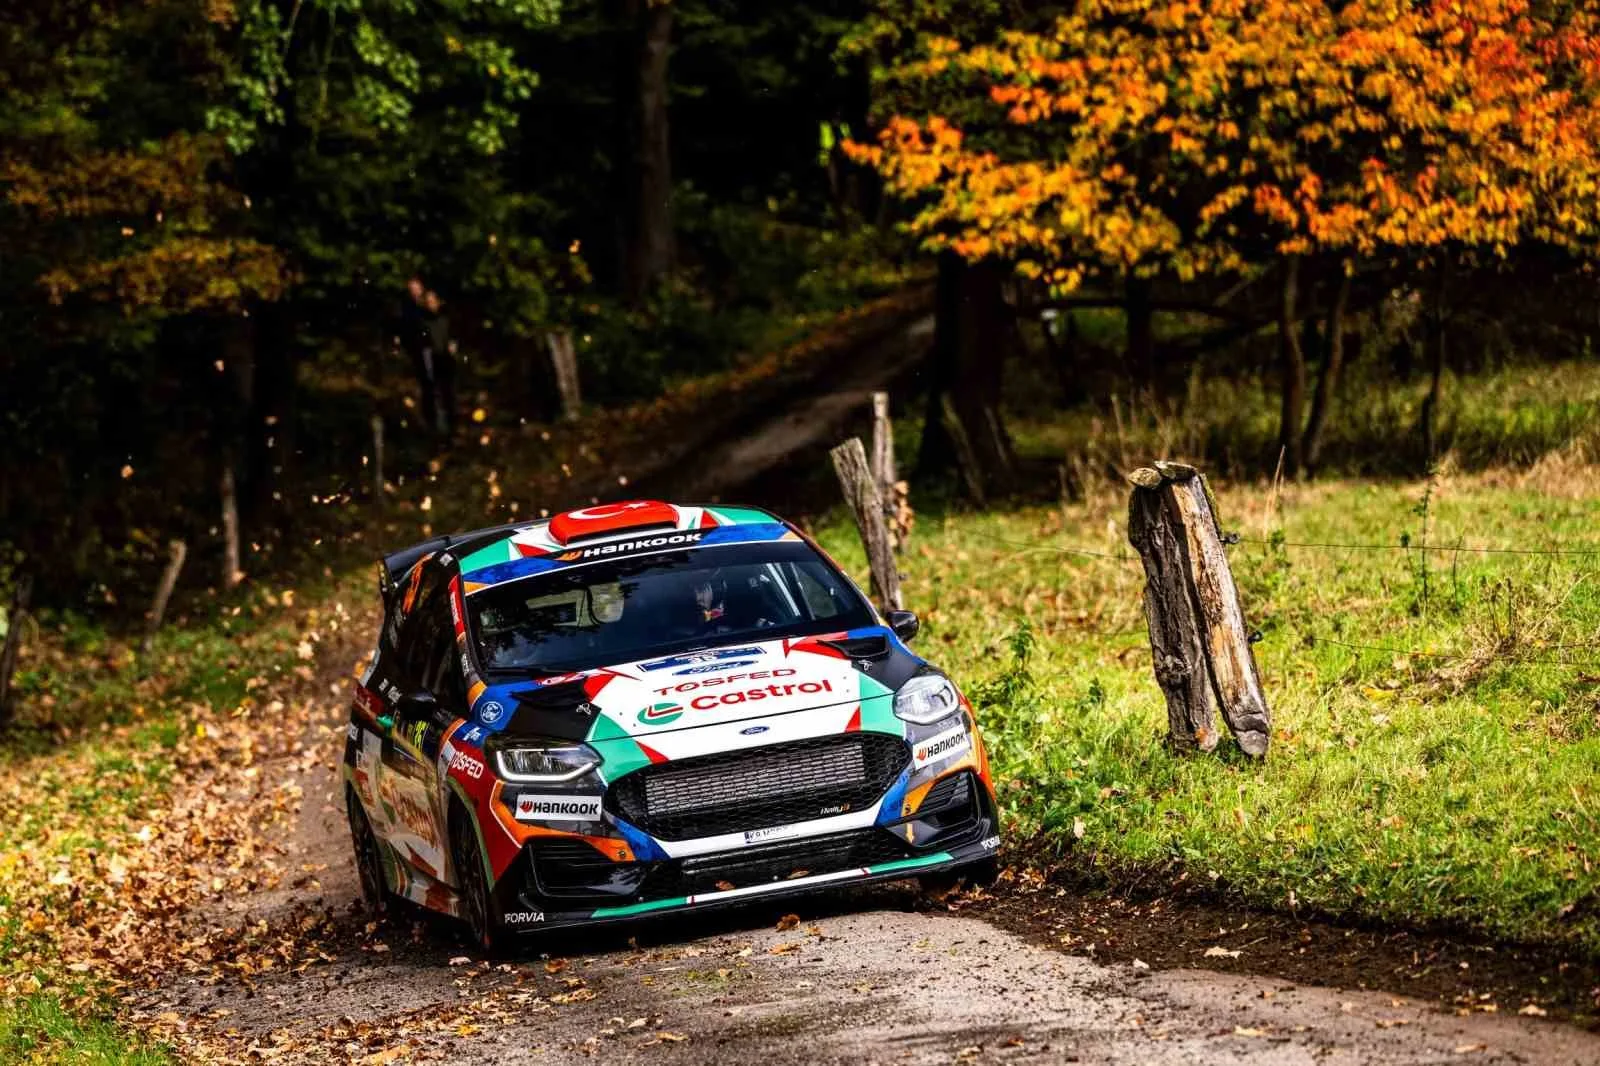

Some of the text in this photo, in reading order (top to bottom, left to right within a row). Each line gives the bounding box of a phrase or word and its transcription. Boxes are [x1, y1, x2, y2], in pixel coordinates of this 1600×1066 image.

[653, 668, 797, 696] TOSFED
[690, 679, 833, 710] Castrol
[504, 912, 545, 924] FORVIA
